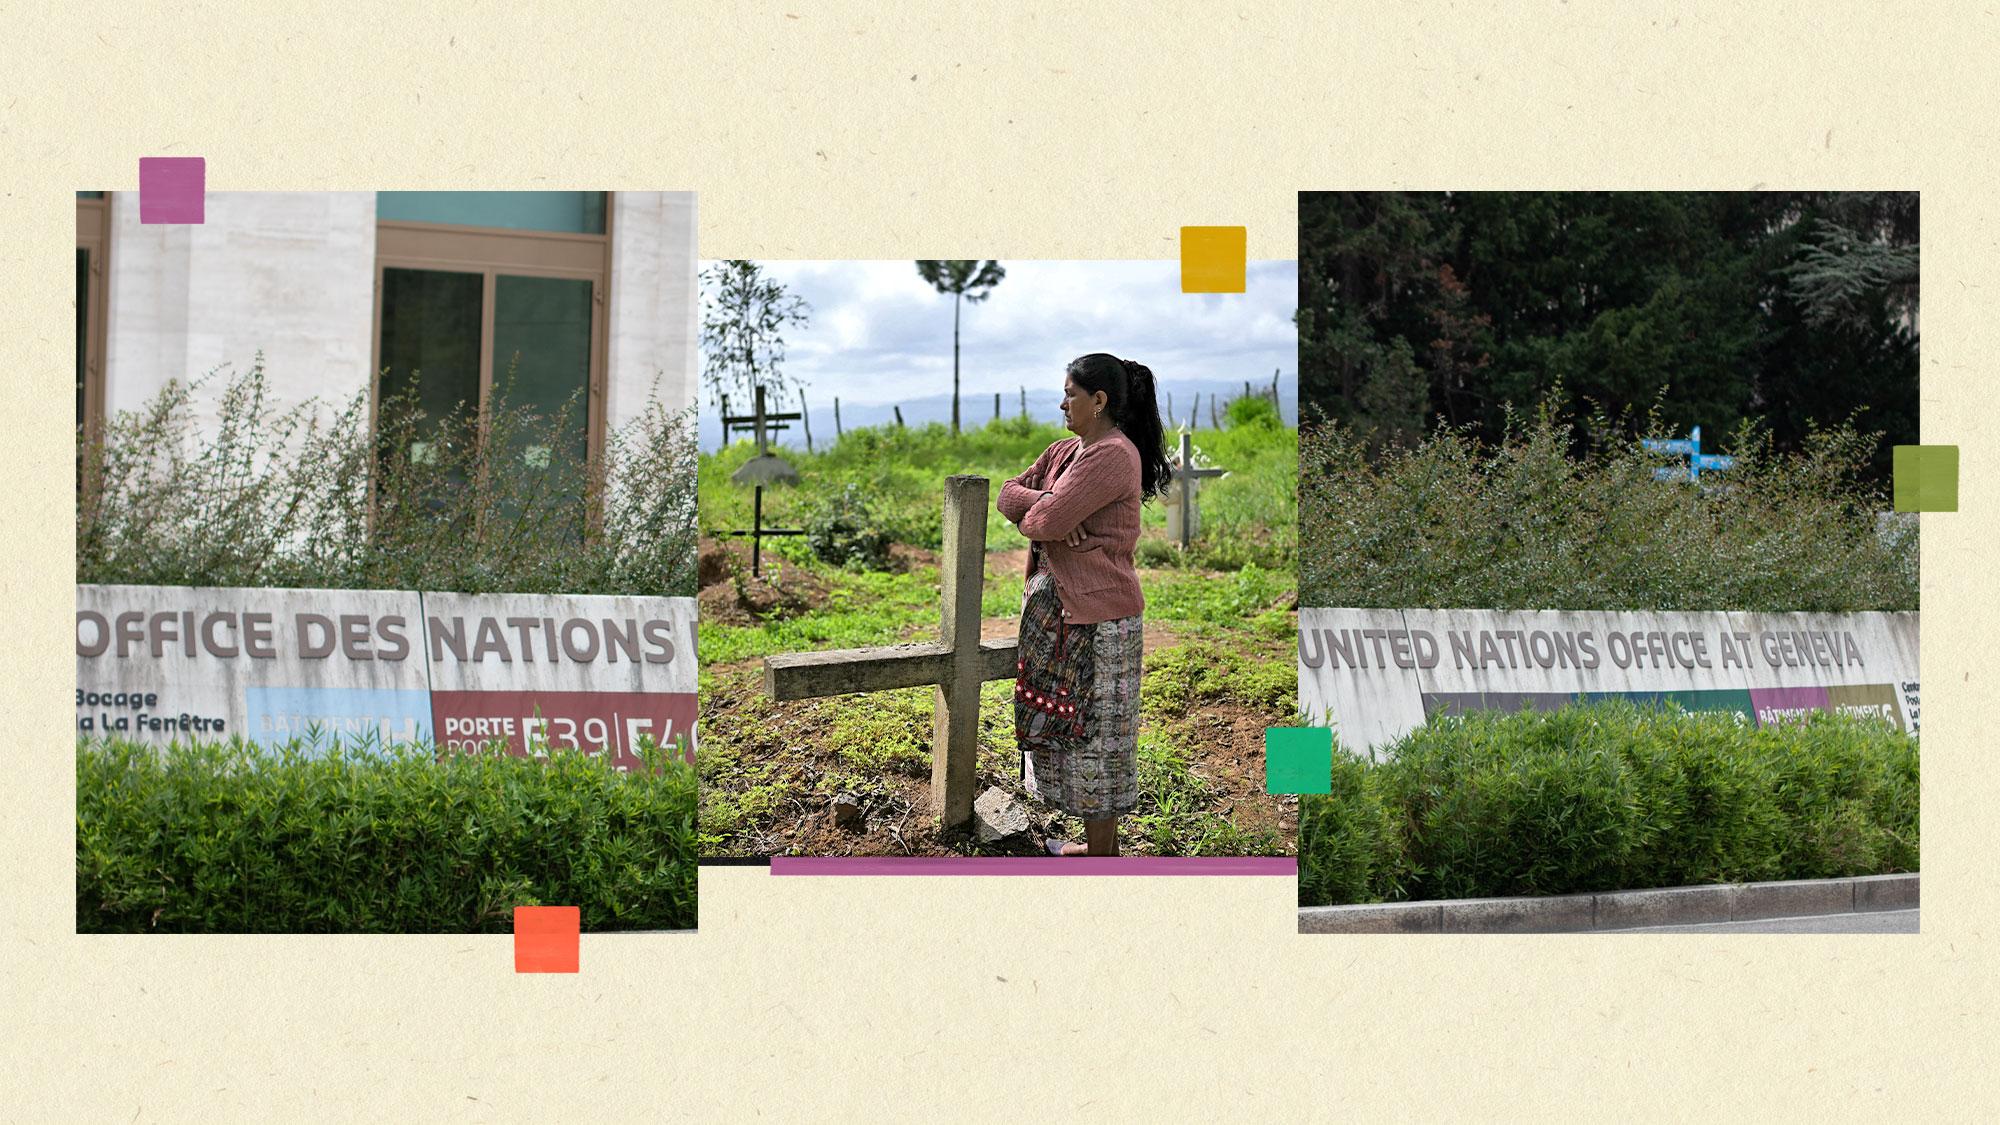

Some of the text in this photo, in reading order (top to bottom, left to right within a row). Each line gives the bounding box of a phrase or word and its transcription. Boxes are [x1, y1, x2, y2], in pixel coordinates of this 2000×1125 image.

[76, 610, 277, 659] OFFICE
[295, 613, 411, 661] DES
[428, 616, 675, 663] NATIONS
[1299, 629, 1865, 670] UNITED NATIONS OFFICE AT GENEVA
[76, 689, 157, 709] Bocage
[102, 713, 128, 731] La
[137, 713, 225, 732] Fenêtre
[1759, 706, 1808, 723] BÂTIMEN
[445, 717, 516, 736] PORTE
[522, 717, 610, 758] E39
